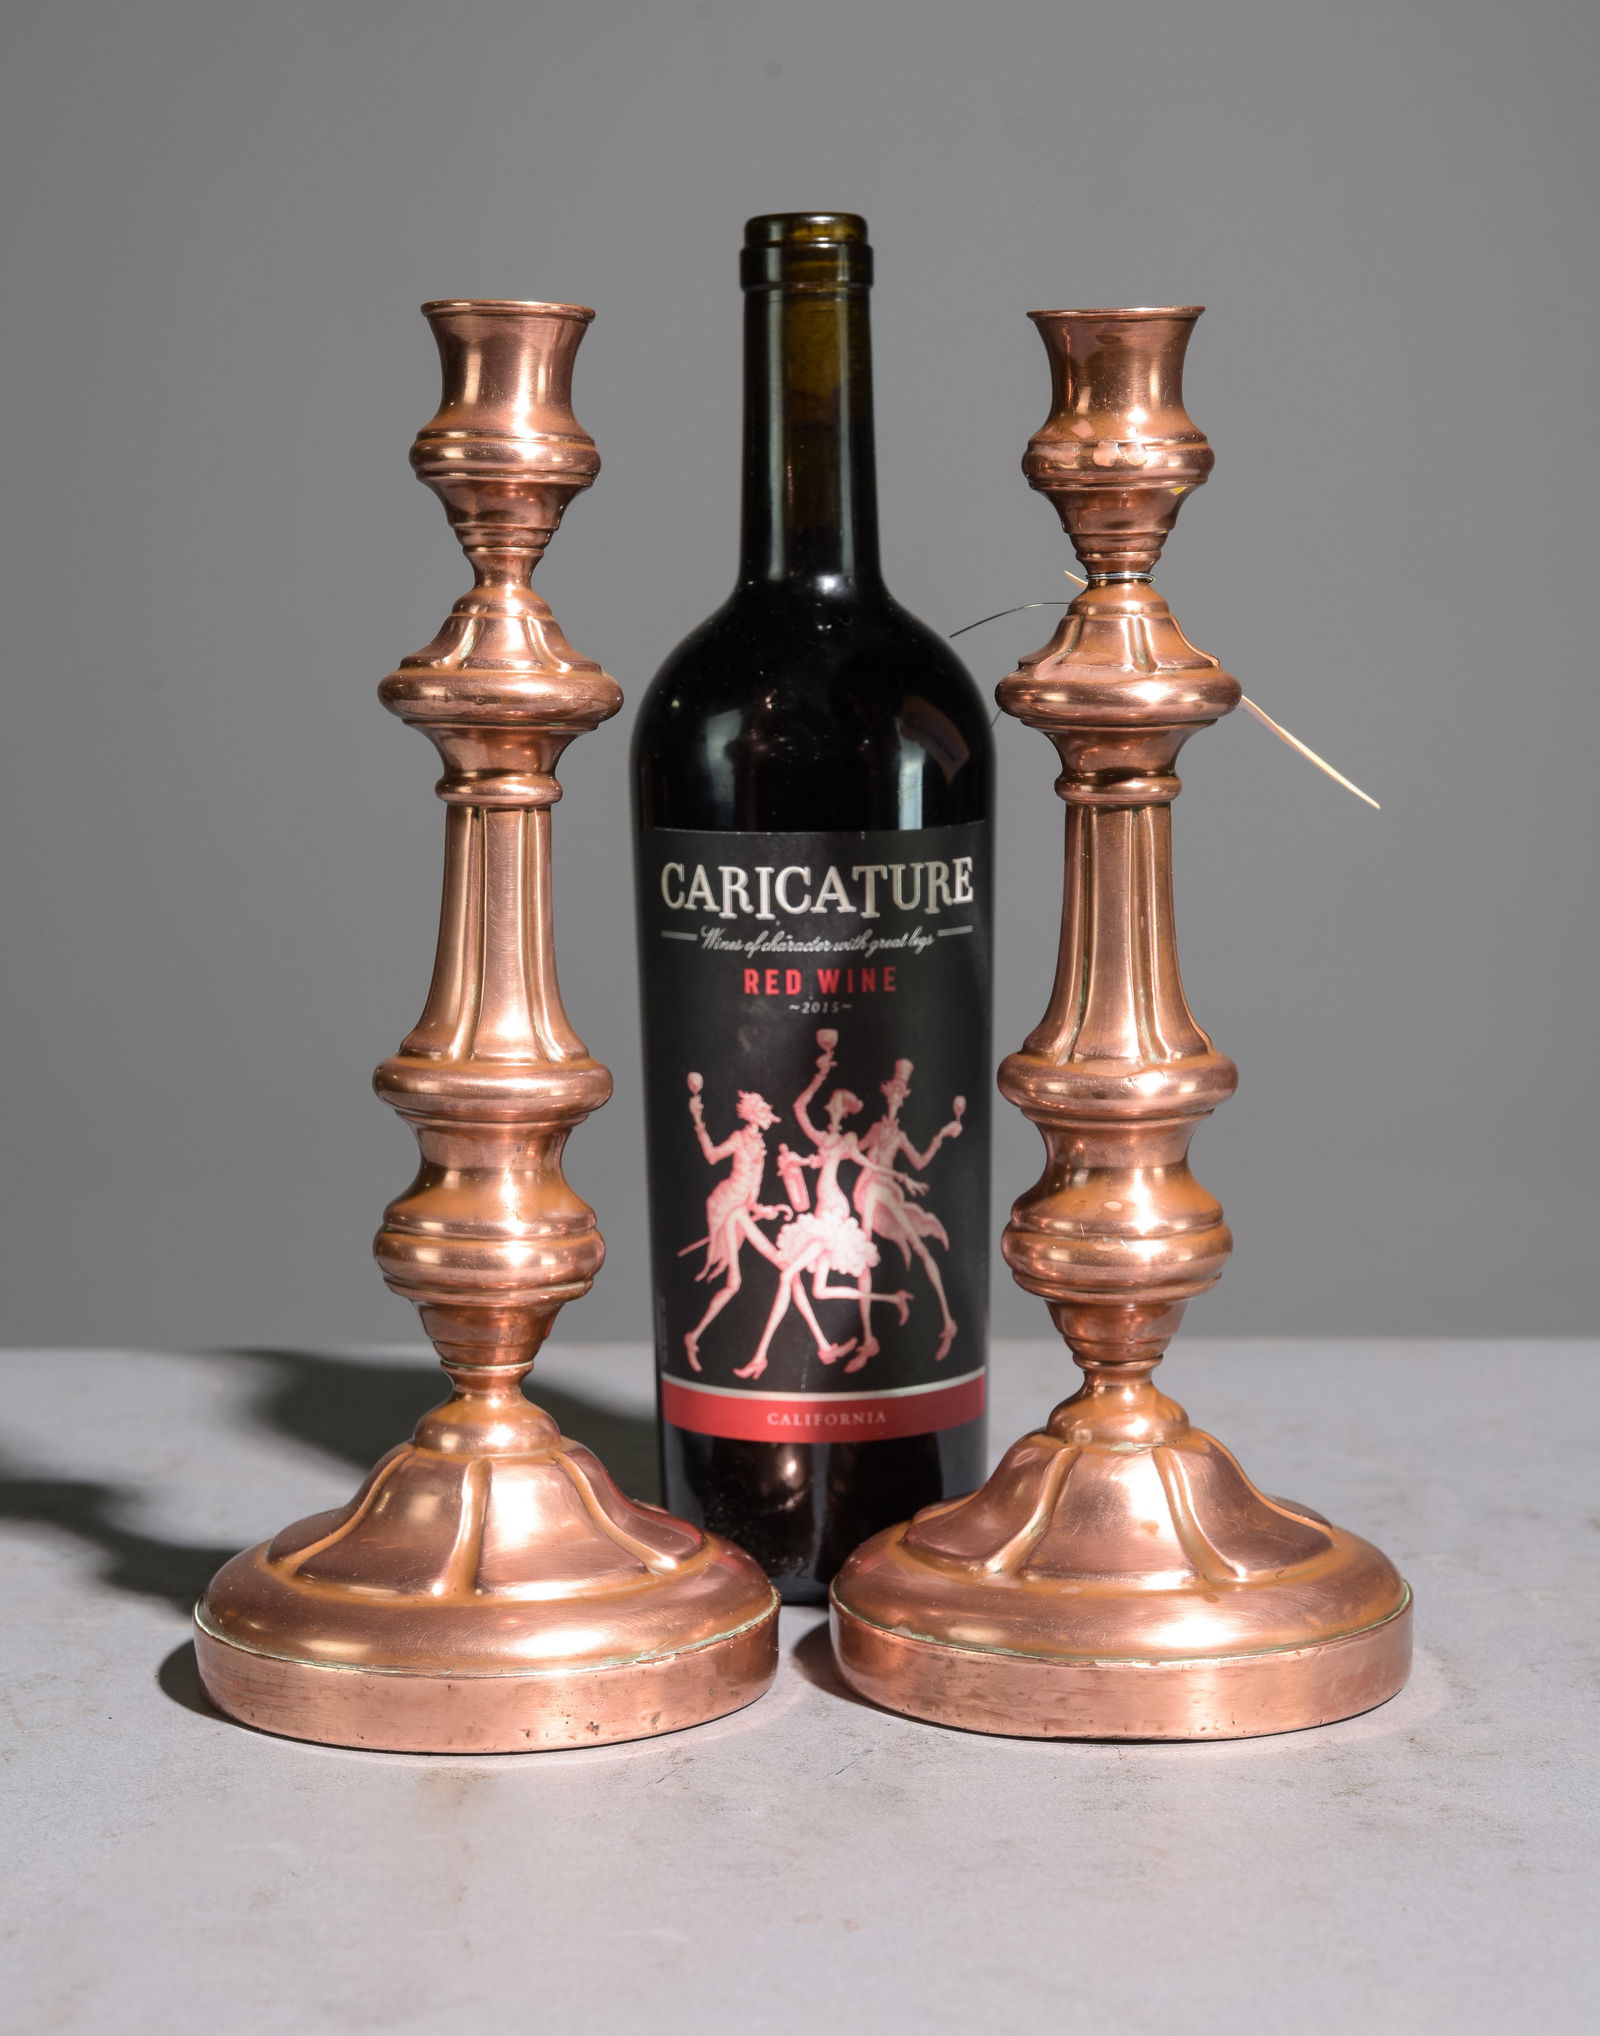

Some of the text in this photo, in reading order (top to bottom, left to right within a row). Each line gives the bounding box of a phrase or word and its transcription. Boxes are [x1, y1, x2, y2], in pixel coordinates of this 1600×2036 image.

[660, 856, 974, 920] CARICATURE
[701, 925, 743, 950] Wines
[743, 929, 770, 959] of
[832, 928, 873, 952] with
[864, 931, 909, 958] great
[907, 925, 935, 955] legs
[743, 966, 897, 995] RED WINE
[766, 1411, 887, 1427] CALIFORNIA
